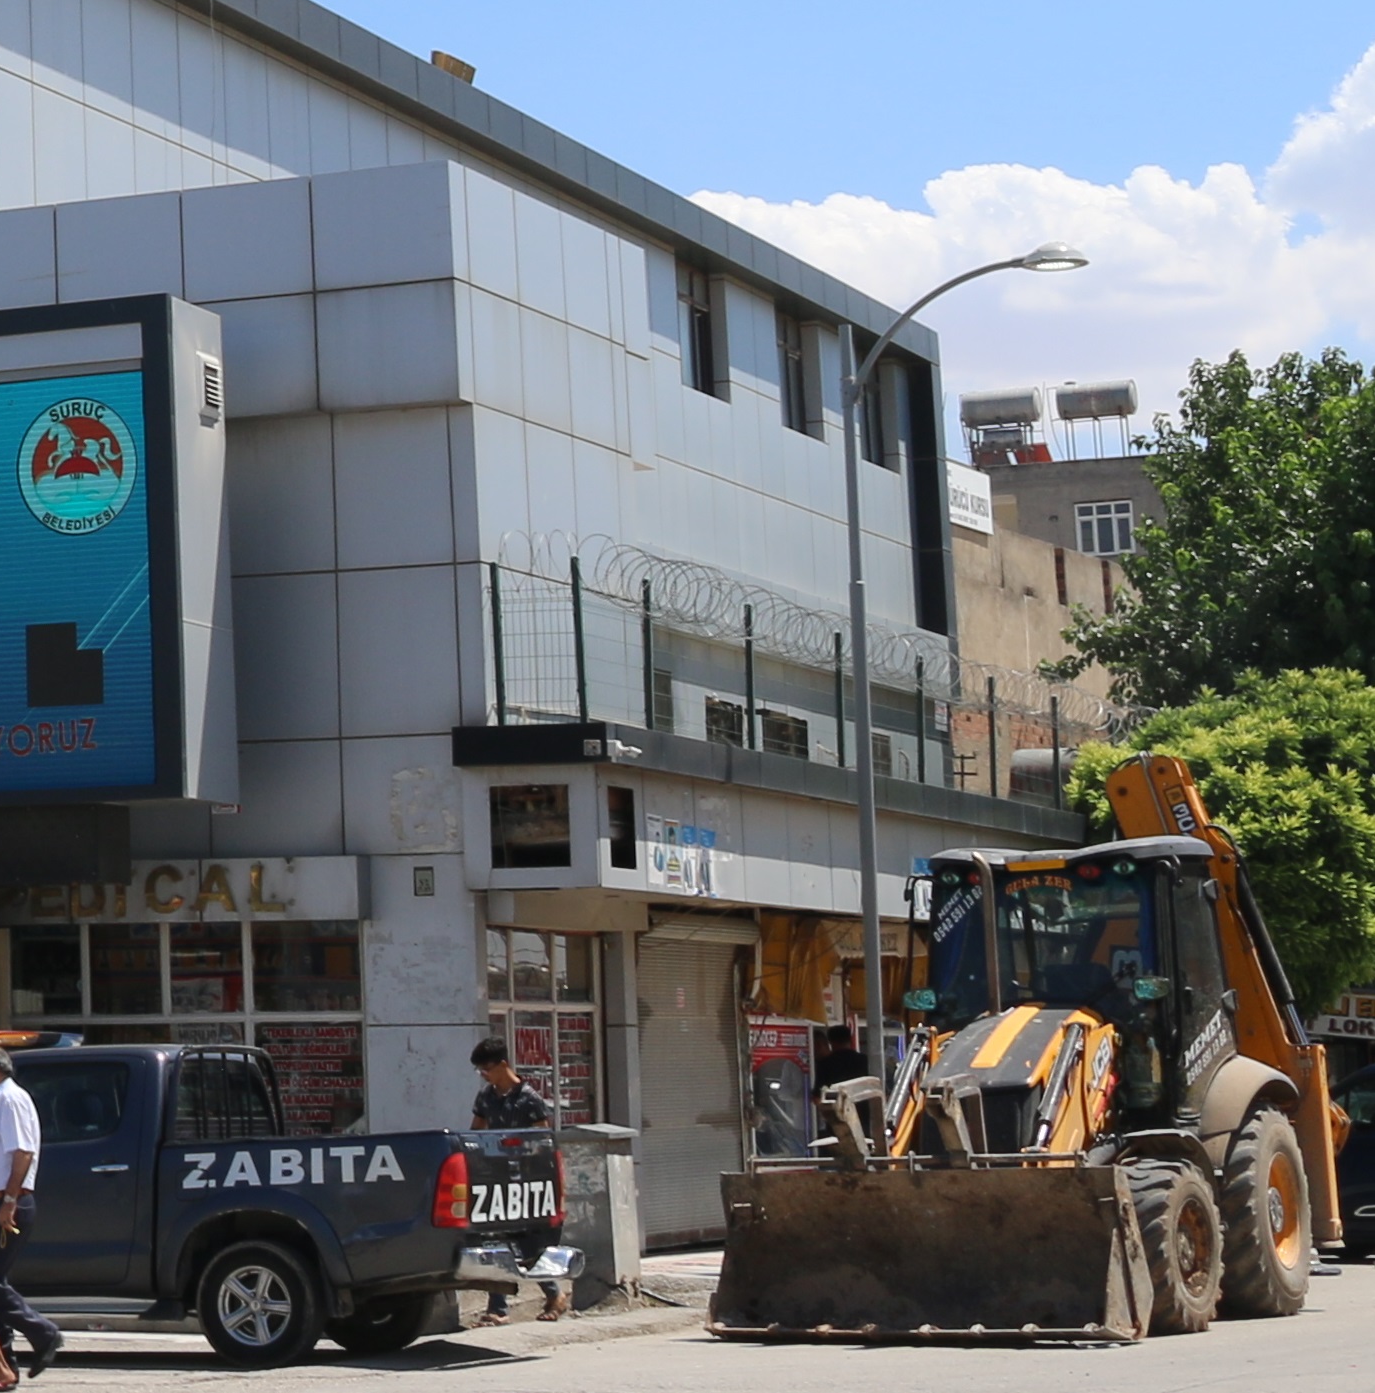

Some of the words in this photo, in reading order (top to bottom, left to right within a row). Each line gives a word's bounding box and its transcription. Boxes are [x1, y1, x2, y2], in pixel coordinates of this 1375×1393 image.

[48, 401, 107, 424] SURUÇ
[41, 505, 117, 532] BELEDİYESİ
[1183, 1008, 1222, 1069] MEMET
[1090, 1036, 1111, 1088] JCB
[182, 1144, 406, 1189] ZABITA
[470, 1180, 557, 1223] ZABITA
